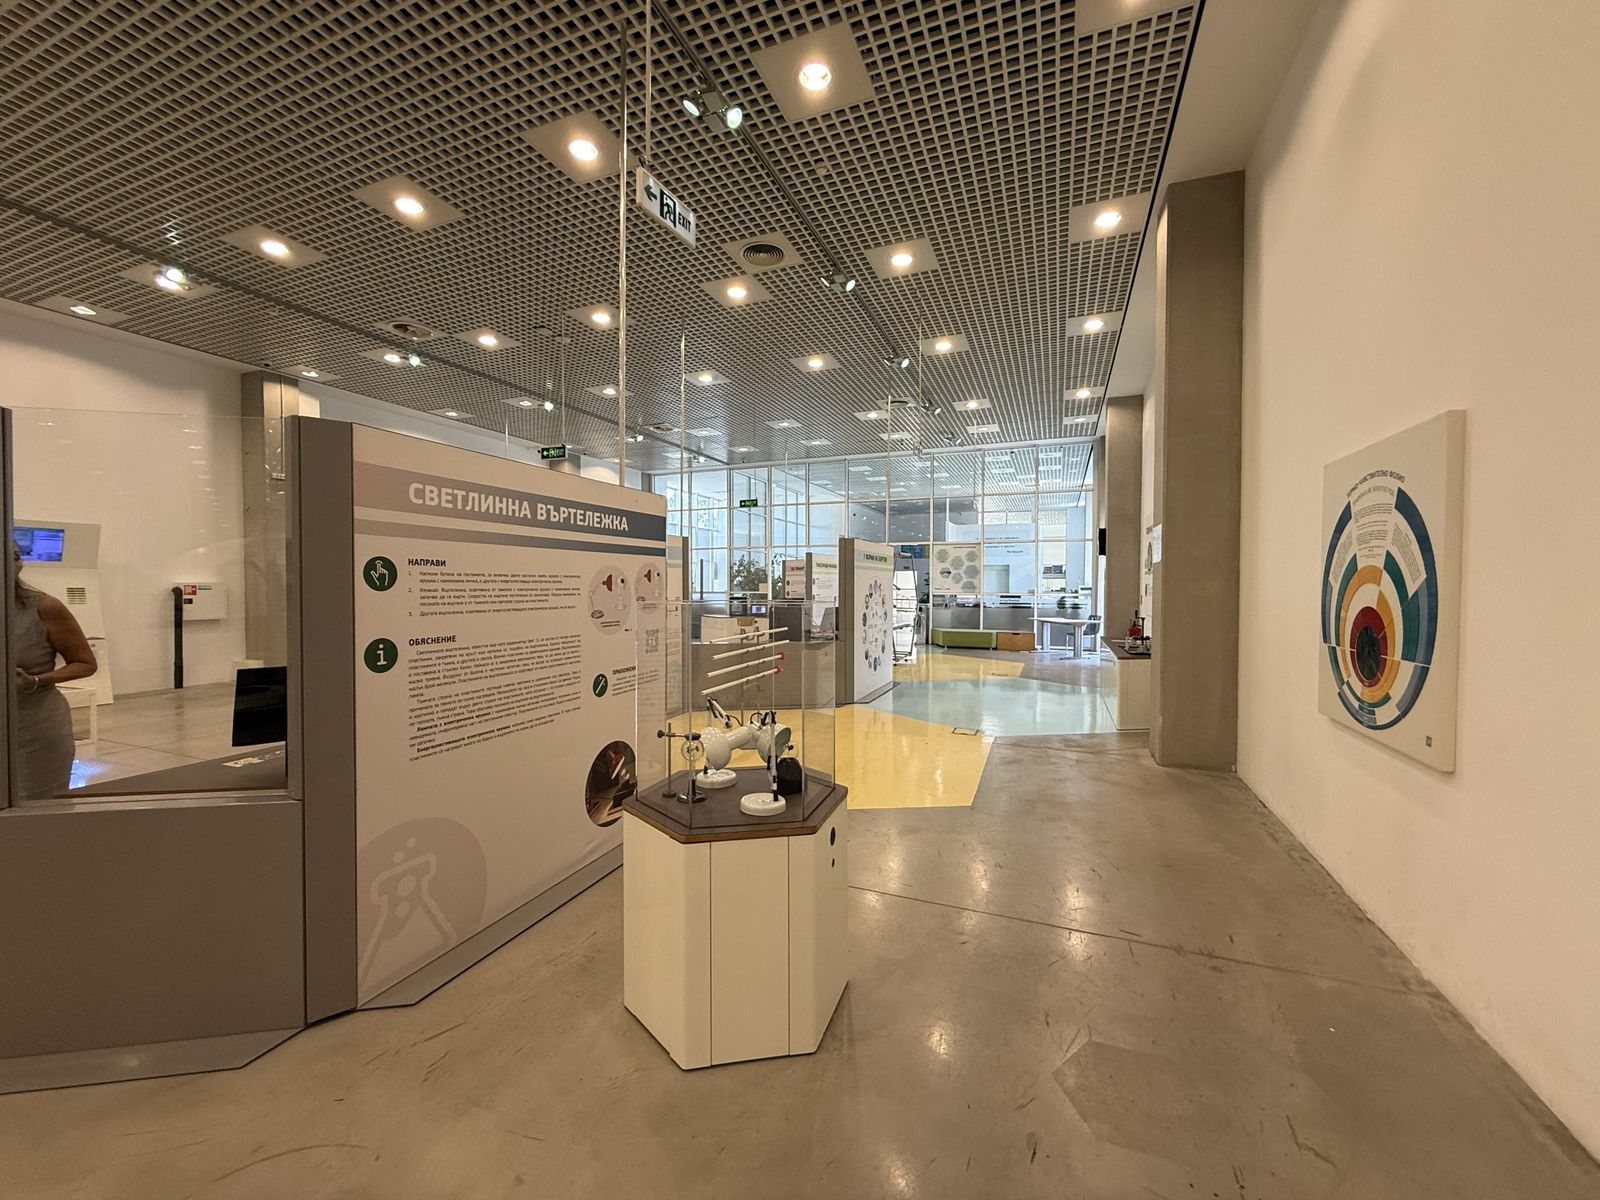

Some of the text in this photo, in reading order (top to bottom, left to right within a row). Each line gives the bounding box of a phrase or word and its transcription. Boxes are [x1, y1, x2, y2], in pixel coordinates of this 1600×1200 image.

[678, 212, 691, 232] EXIT
[408, 482, 628, 532] СВЕТЛИННА ВЪРТЕЛЕЖКА
[408, 558, 446, 568] НАПРАВИ
[409, 635, 456, 646] ОБЯСНЕНИЕ
